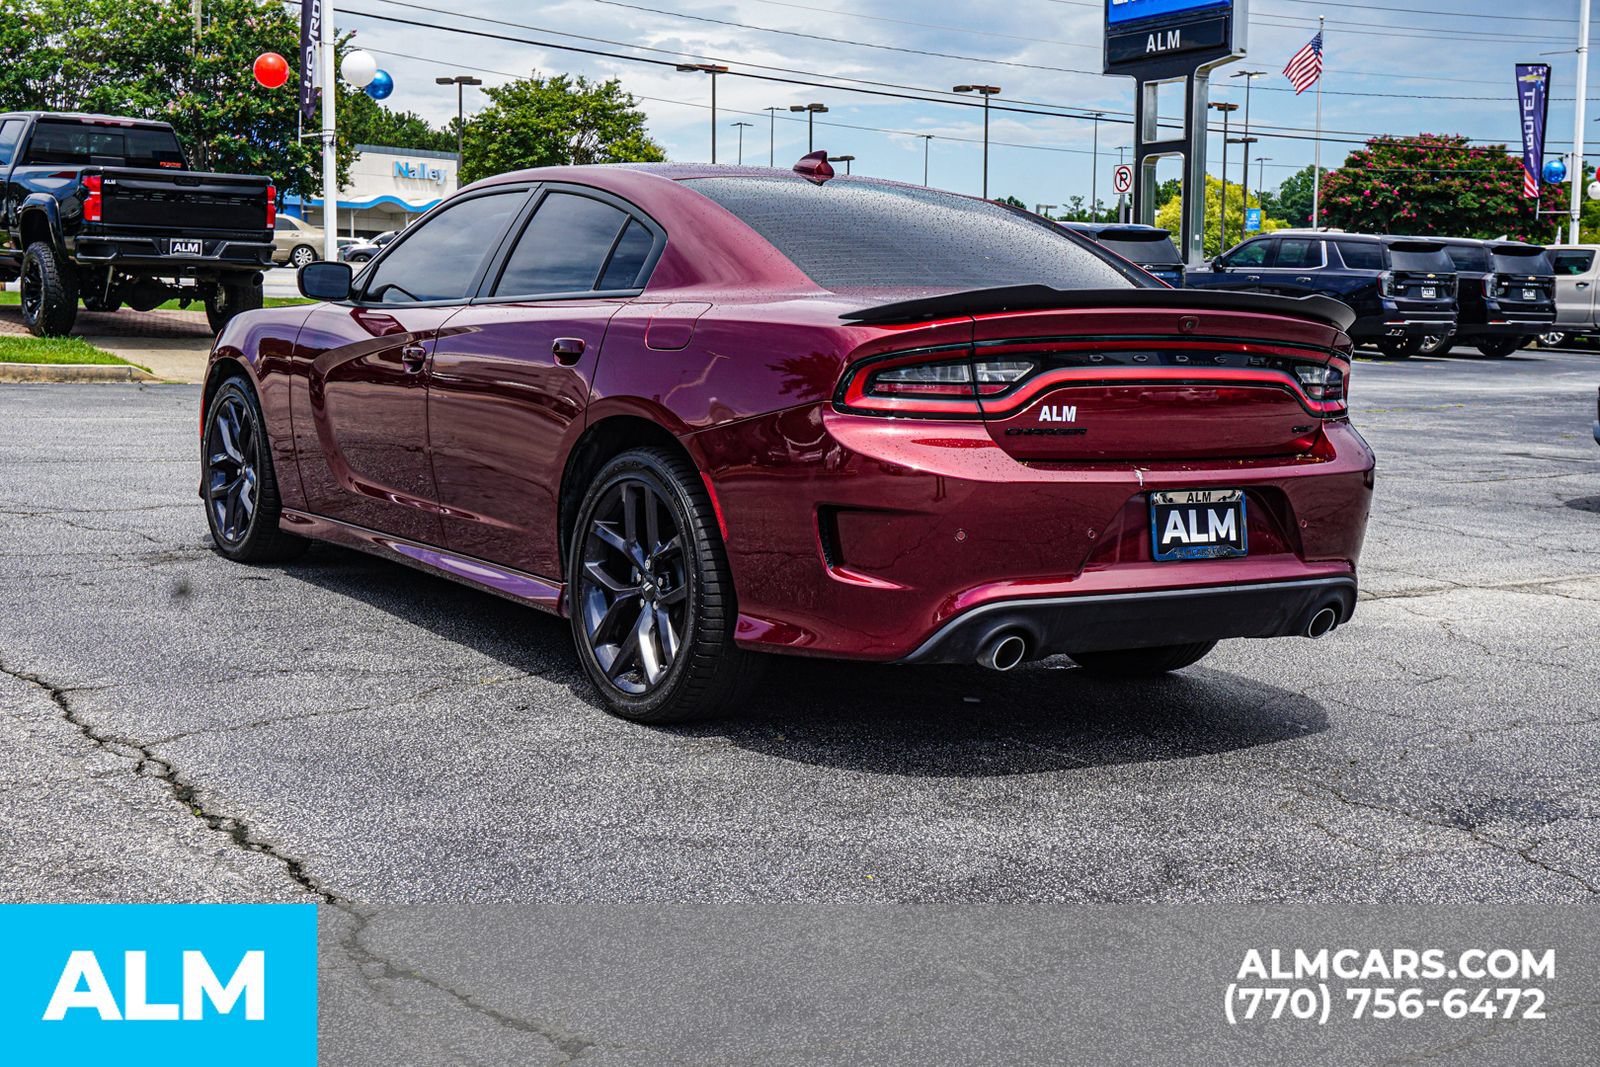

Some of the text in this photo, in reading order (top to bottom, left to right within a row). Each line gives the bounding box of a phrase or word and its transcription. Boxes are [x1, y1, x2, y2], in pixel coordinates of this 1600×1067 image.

[1145, 29, 1180, 53] ALM
[393, 161, 447, 185] Nalley
[173, 242, 199, 253] ALM
[1089, 353, 1266, 366] DODGE
[1038, 405, 1077, 423] ALM
[1186, 491, 1212, 504] ALM
[1161, 507, 1237, 545] ALM
